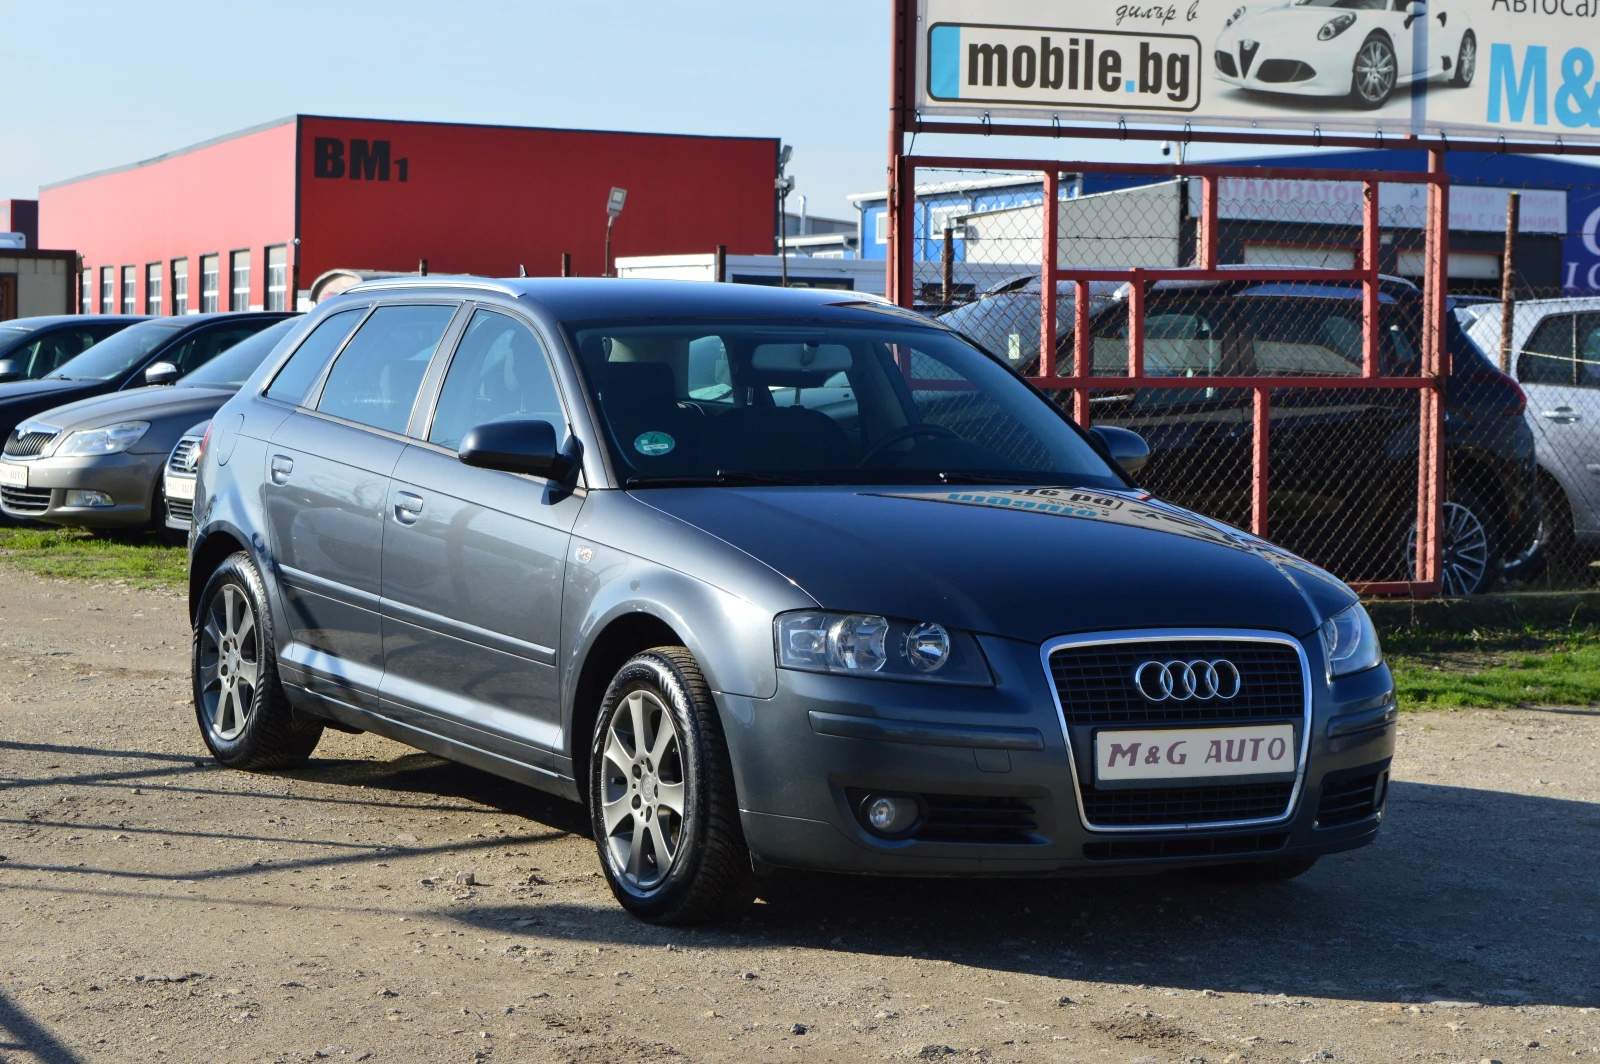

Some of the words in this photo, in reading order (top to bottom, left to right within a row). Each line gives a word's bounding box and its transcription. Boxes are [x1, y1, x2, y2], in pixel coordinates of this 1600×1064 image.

[967, 36, 1190, 102] mobile.bg
[1217, 178, 1365, 204] АТАЛИЗАТОР
[1107, 740, 1188, 768] M&G
[1204, 737, 1286, 764] AUTO
